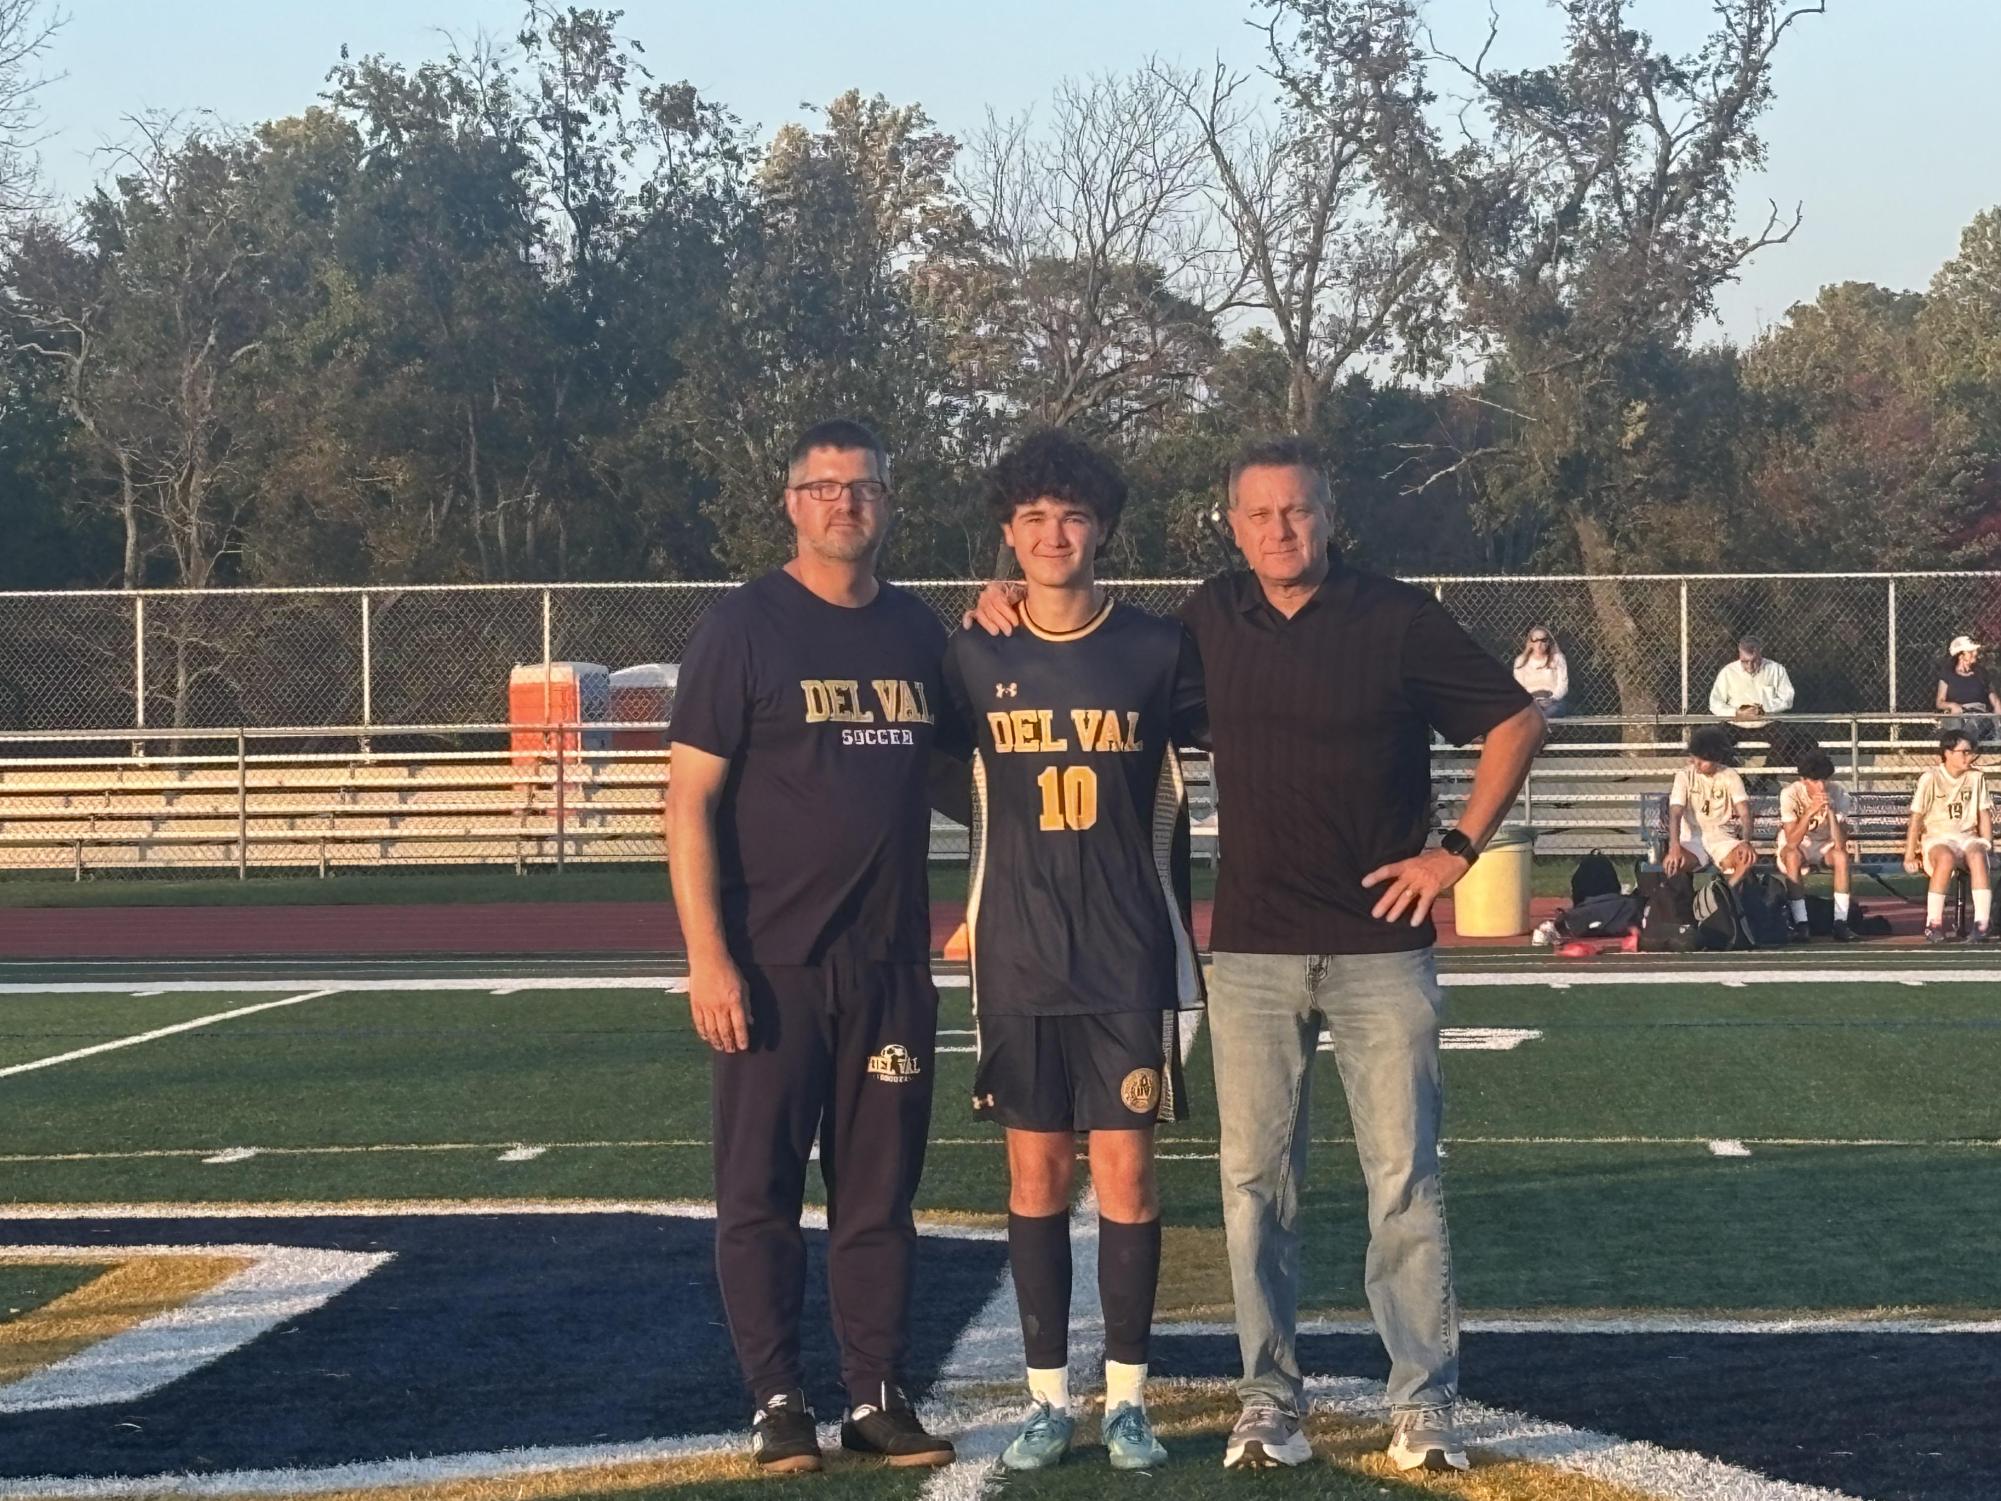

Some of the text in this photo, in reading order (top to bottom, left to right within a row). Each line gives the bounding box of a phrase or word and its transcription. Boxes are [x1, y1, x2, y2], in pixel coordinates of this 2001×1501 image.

[800, 680, 934, 725] DEL VAL
[842, 729, 913, 745] SOCCER
[987, 709, 1143, 753] DEL VAL
[1038, 766, 1097, 831] 10
[1948, 802, 1963, 819] 19
